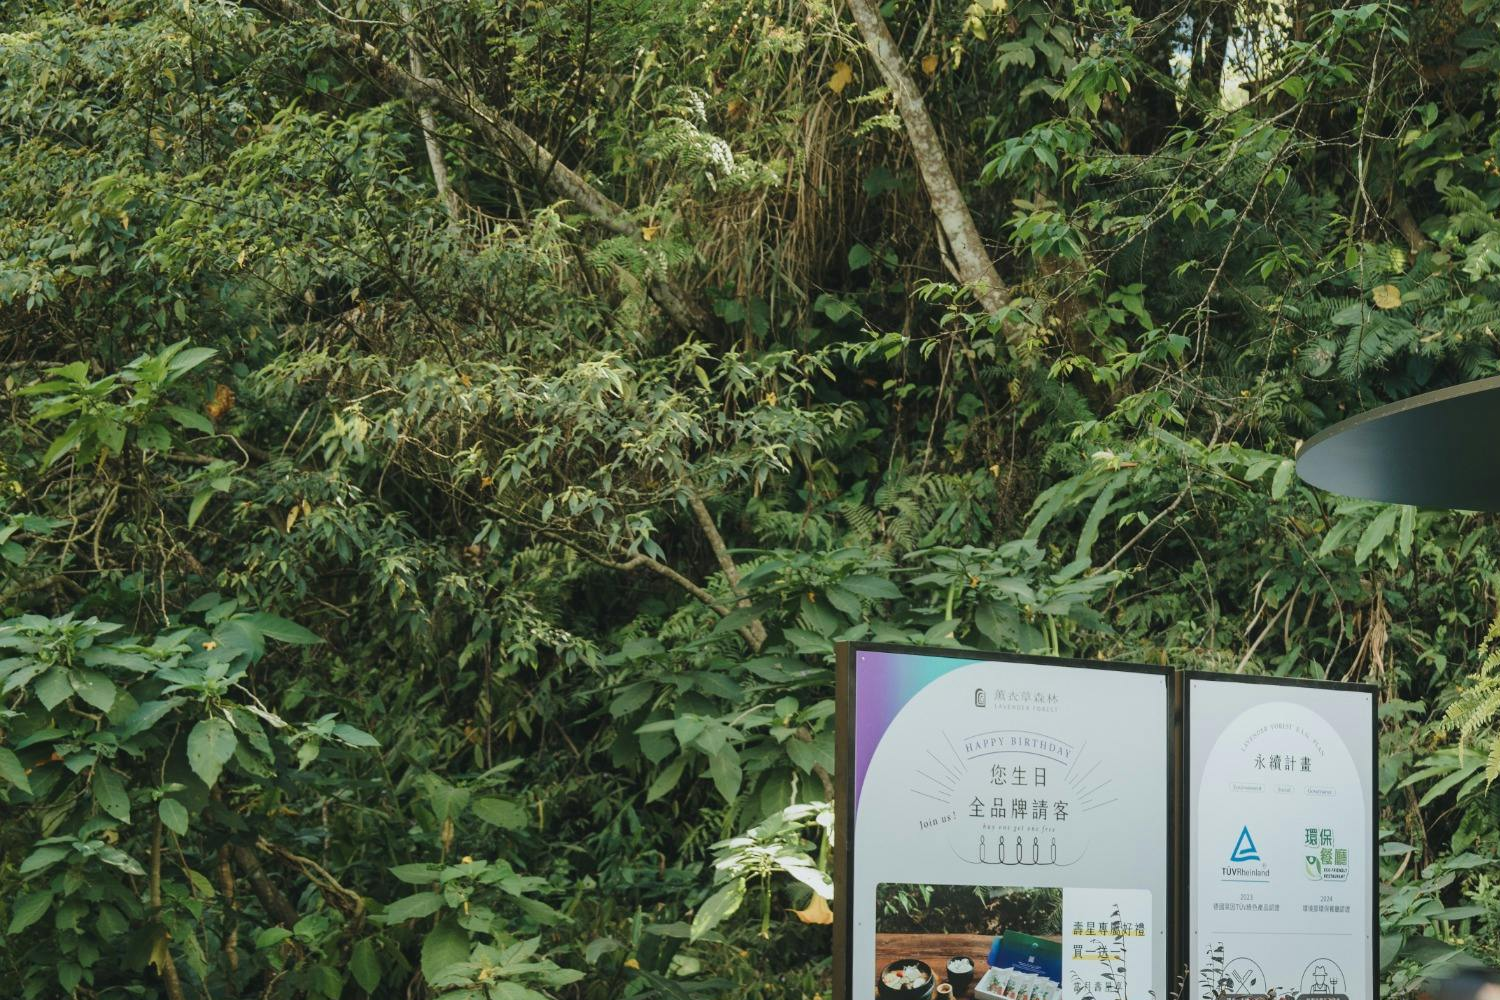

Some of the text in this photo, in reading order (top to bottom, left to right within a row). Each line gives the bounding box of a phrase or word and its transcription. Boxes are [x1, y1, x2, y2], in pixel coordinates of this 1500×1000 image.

[965, 736, 1072, 759] HAPPY BIRTHDAY
[1254, 753, 1312, 772] 永續計畫
[990, 763, 1047, 787] 您生日
[968, 795, 1069, 821] 全品牌請客
[919, 810, 957, 830] Join us!
[1304, 828, 1333, 846] 環保
[1320, 847, 1348, 866] 餐廳
